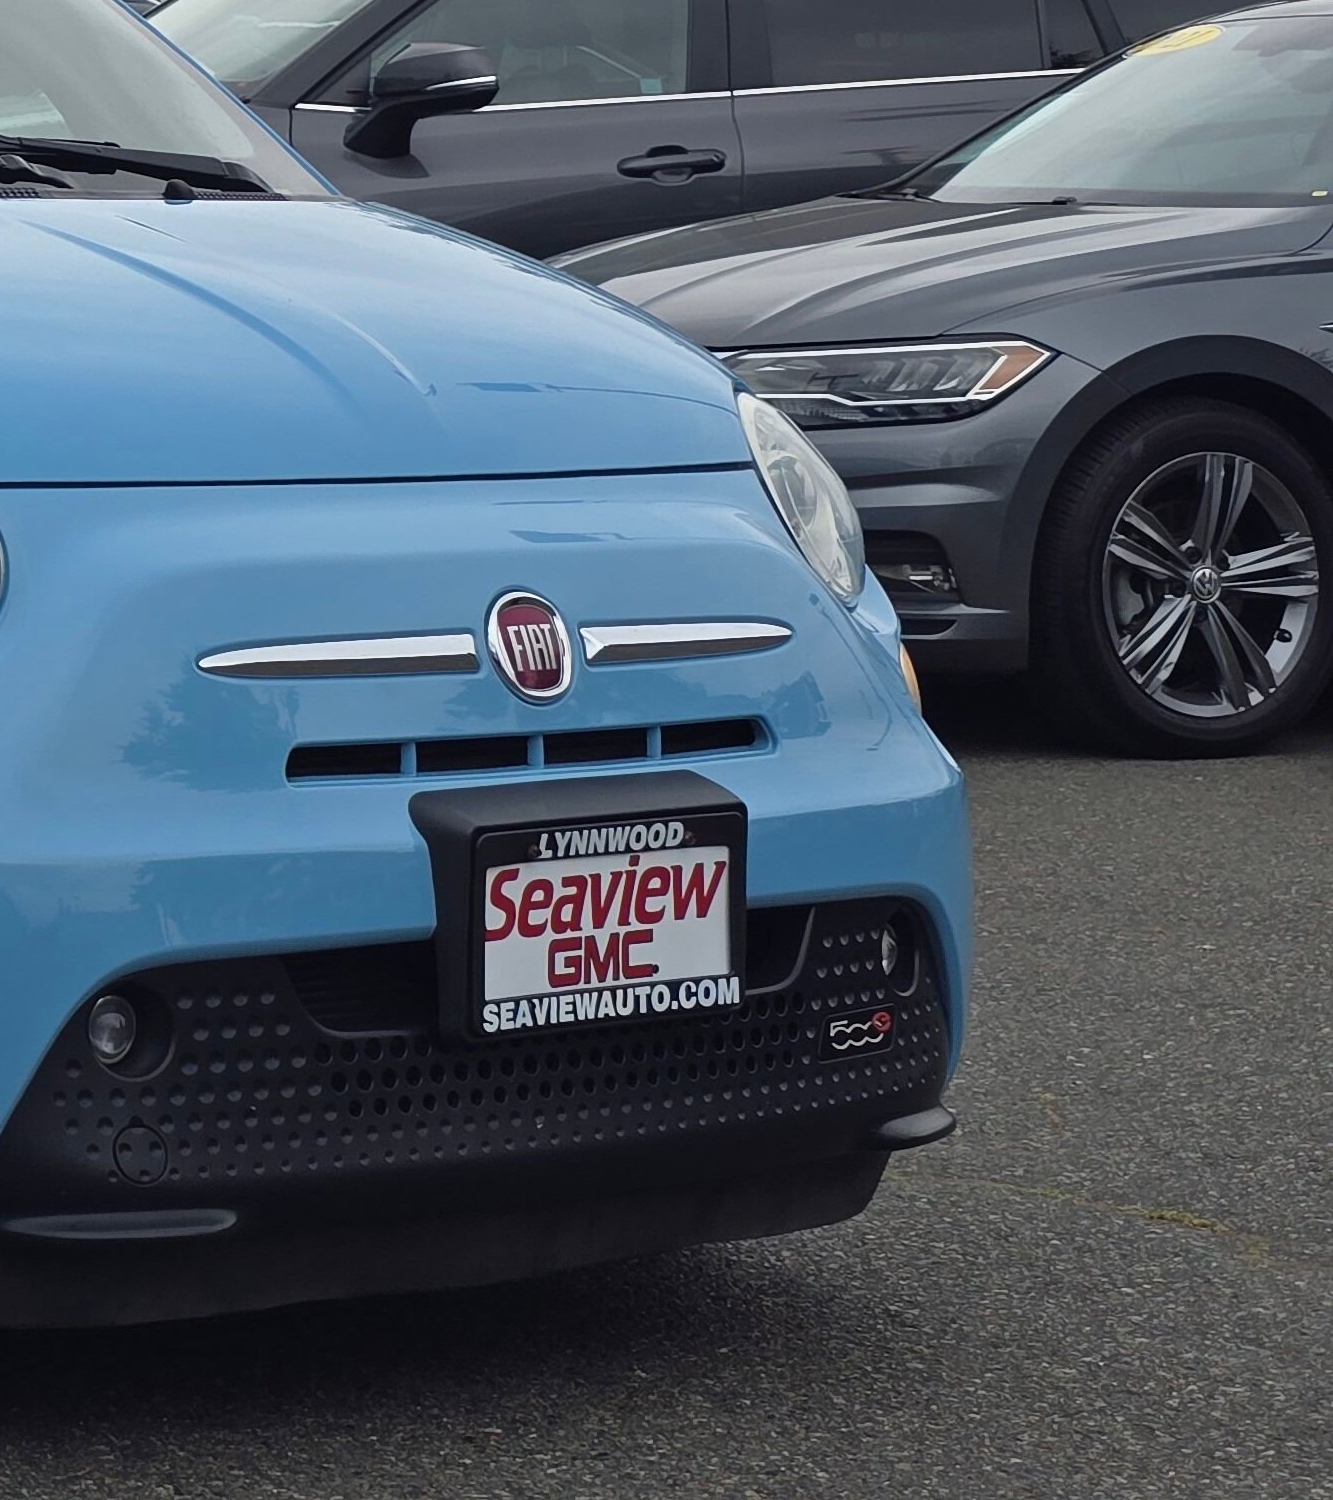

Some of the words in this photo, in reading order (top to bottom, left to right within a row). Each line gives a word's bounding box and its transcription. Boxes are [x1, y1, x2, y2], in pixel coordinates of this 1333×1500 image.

[507, 624, 557, 671] FIAT
[538, 821, 684, 859] LYNNWOOD
[484, 854, 727, 942] Seaview
[548, 928, 655, 988] GMC
[483, 976, 740, 1033] SEAVIEWAUTO.COM
